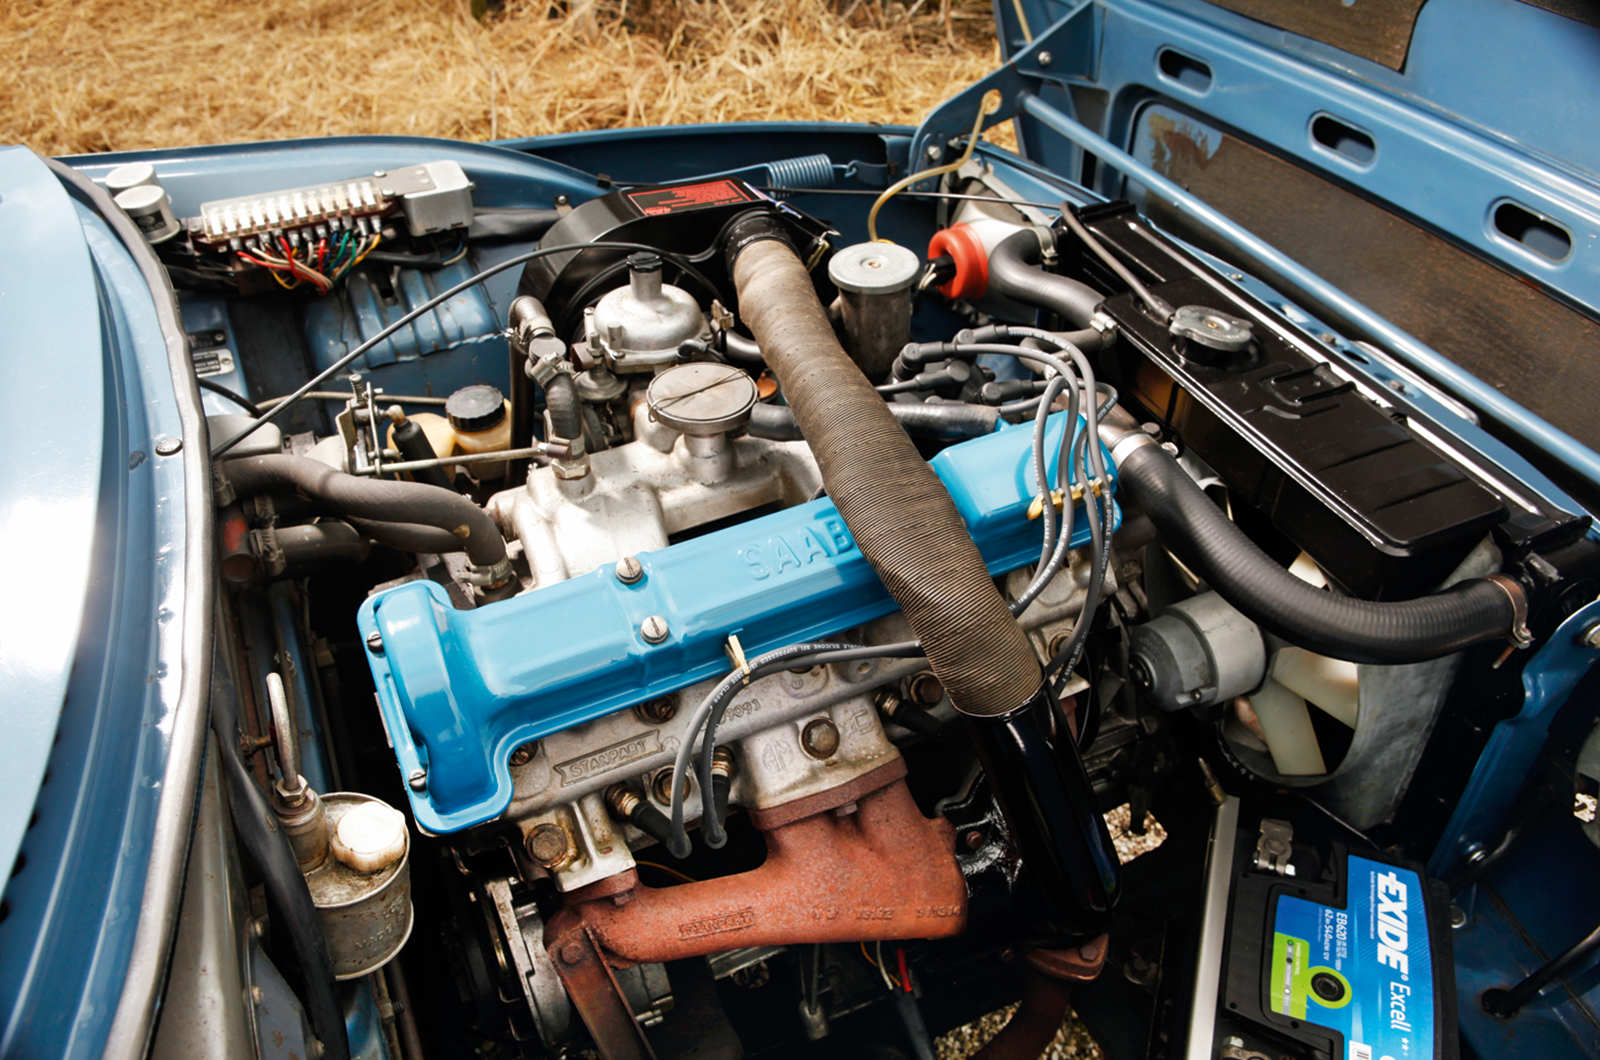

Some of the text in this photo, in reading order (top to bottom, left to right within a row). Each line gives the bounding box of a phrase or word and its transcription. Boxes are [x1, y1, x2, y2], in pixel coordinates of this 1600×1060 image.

[743, 519, 855, 581] SAAB
[1017, 524, 1069, 604] 7MM DOUBLE SILICONE RFI
[1101, 540, 1111, 570] SILICONE
[760, 647, 798, 665] SUPPRESSED
[1064, 658, 1076, 676] CLASS
[713, 684, 731, 704] CLASS
[570, 739, 648, 777] STANPART
[355, 924, 394, 952] MADE
[1336, 912, 1348, 941] EB620
[1377, 871, 1412, 1032] EXIDE Excell
